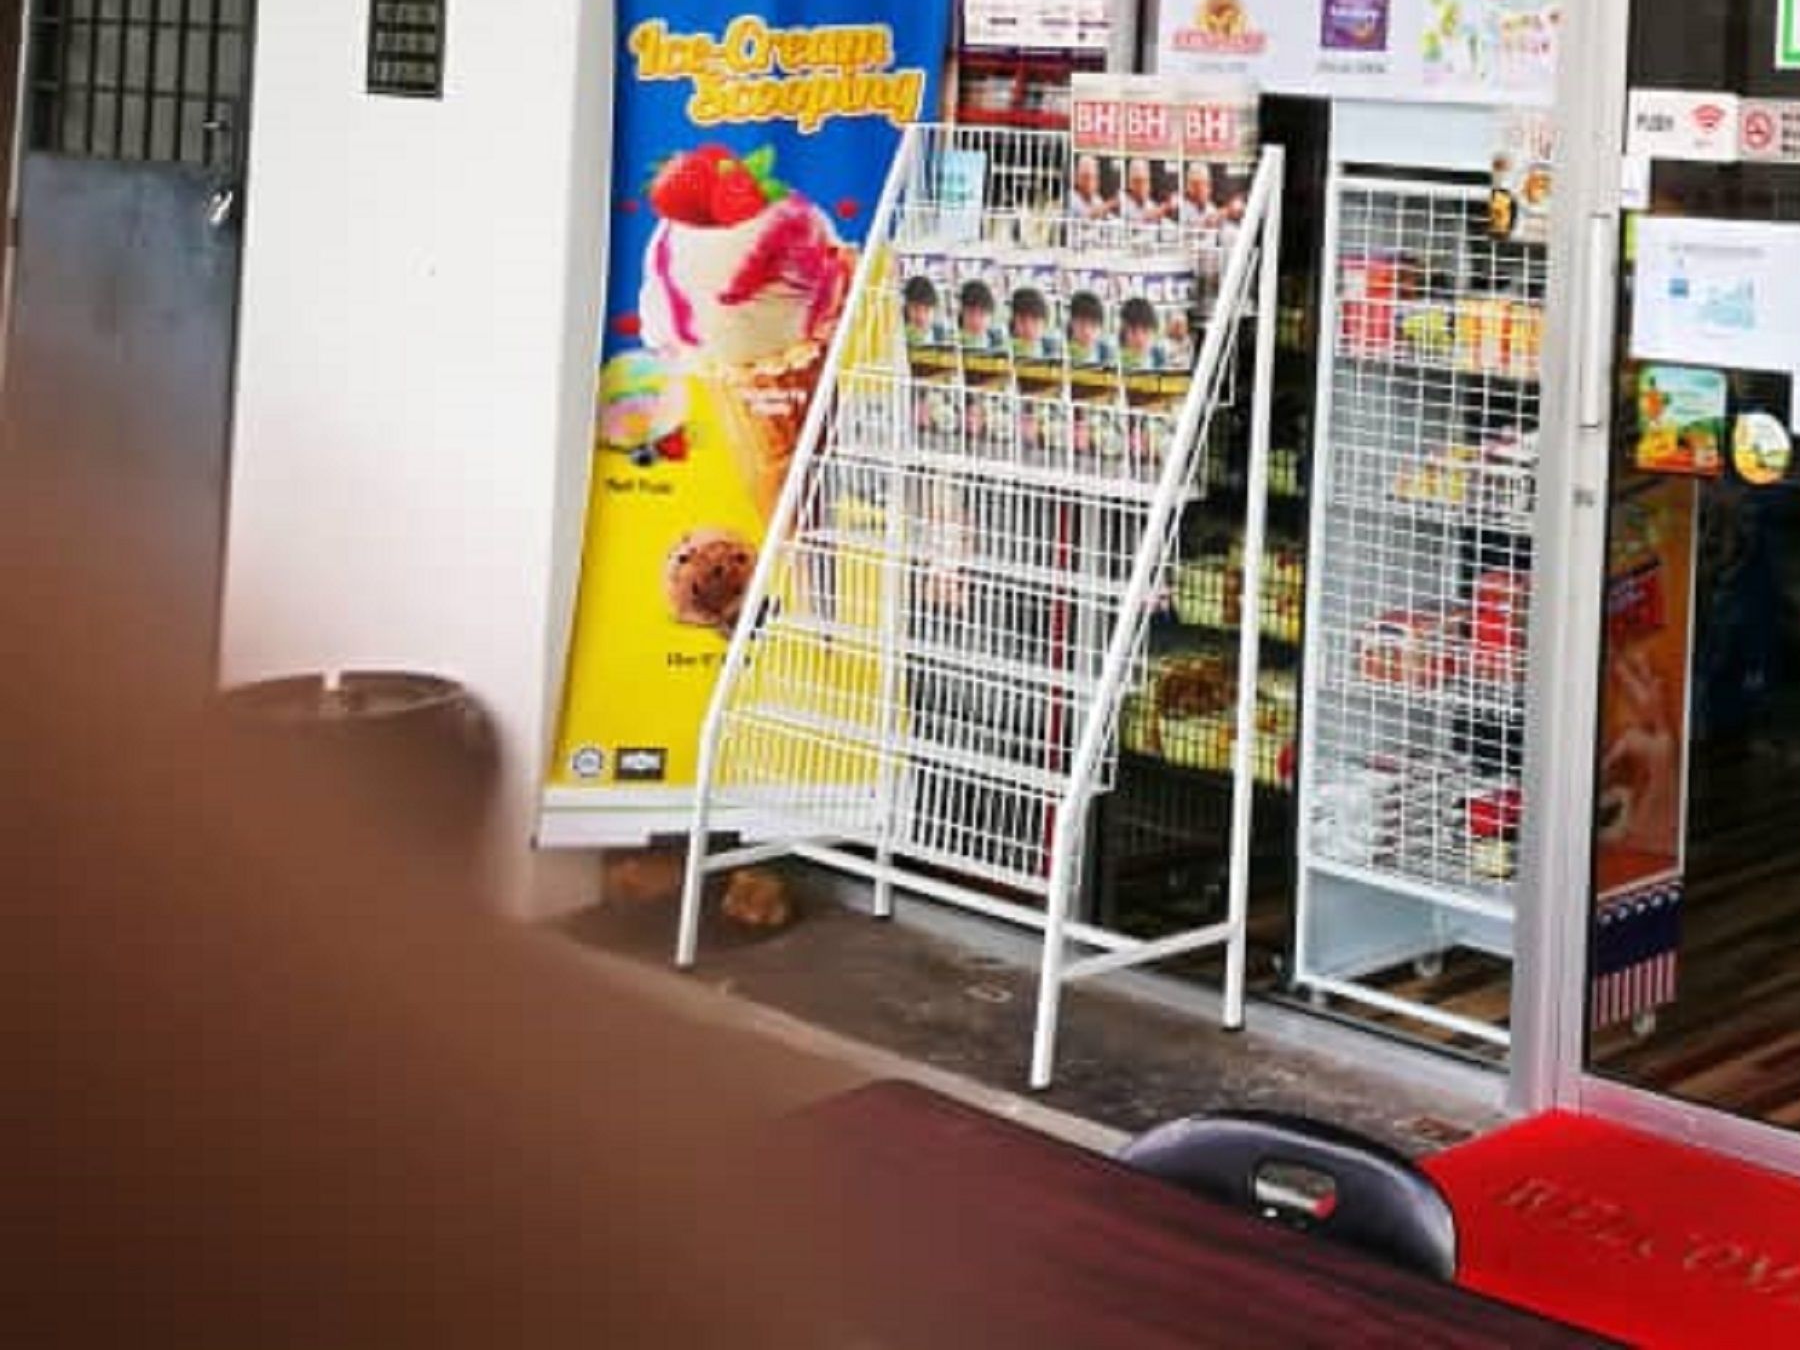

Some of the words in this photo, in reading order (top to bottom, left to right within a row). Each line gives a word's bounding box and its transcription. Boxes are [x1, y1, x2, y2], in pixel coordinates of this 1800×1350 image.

[1077, 102, 1119, 136] BH
[1127, 104, 1170, 139] BH
[1186, 110, 1230, 140] BH
